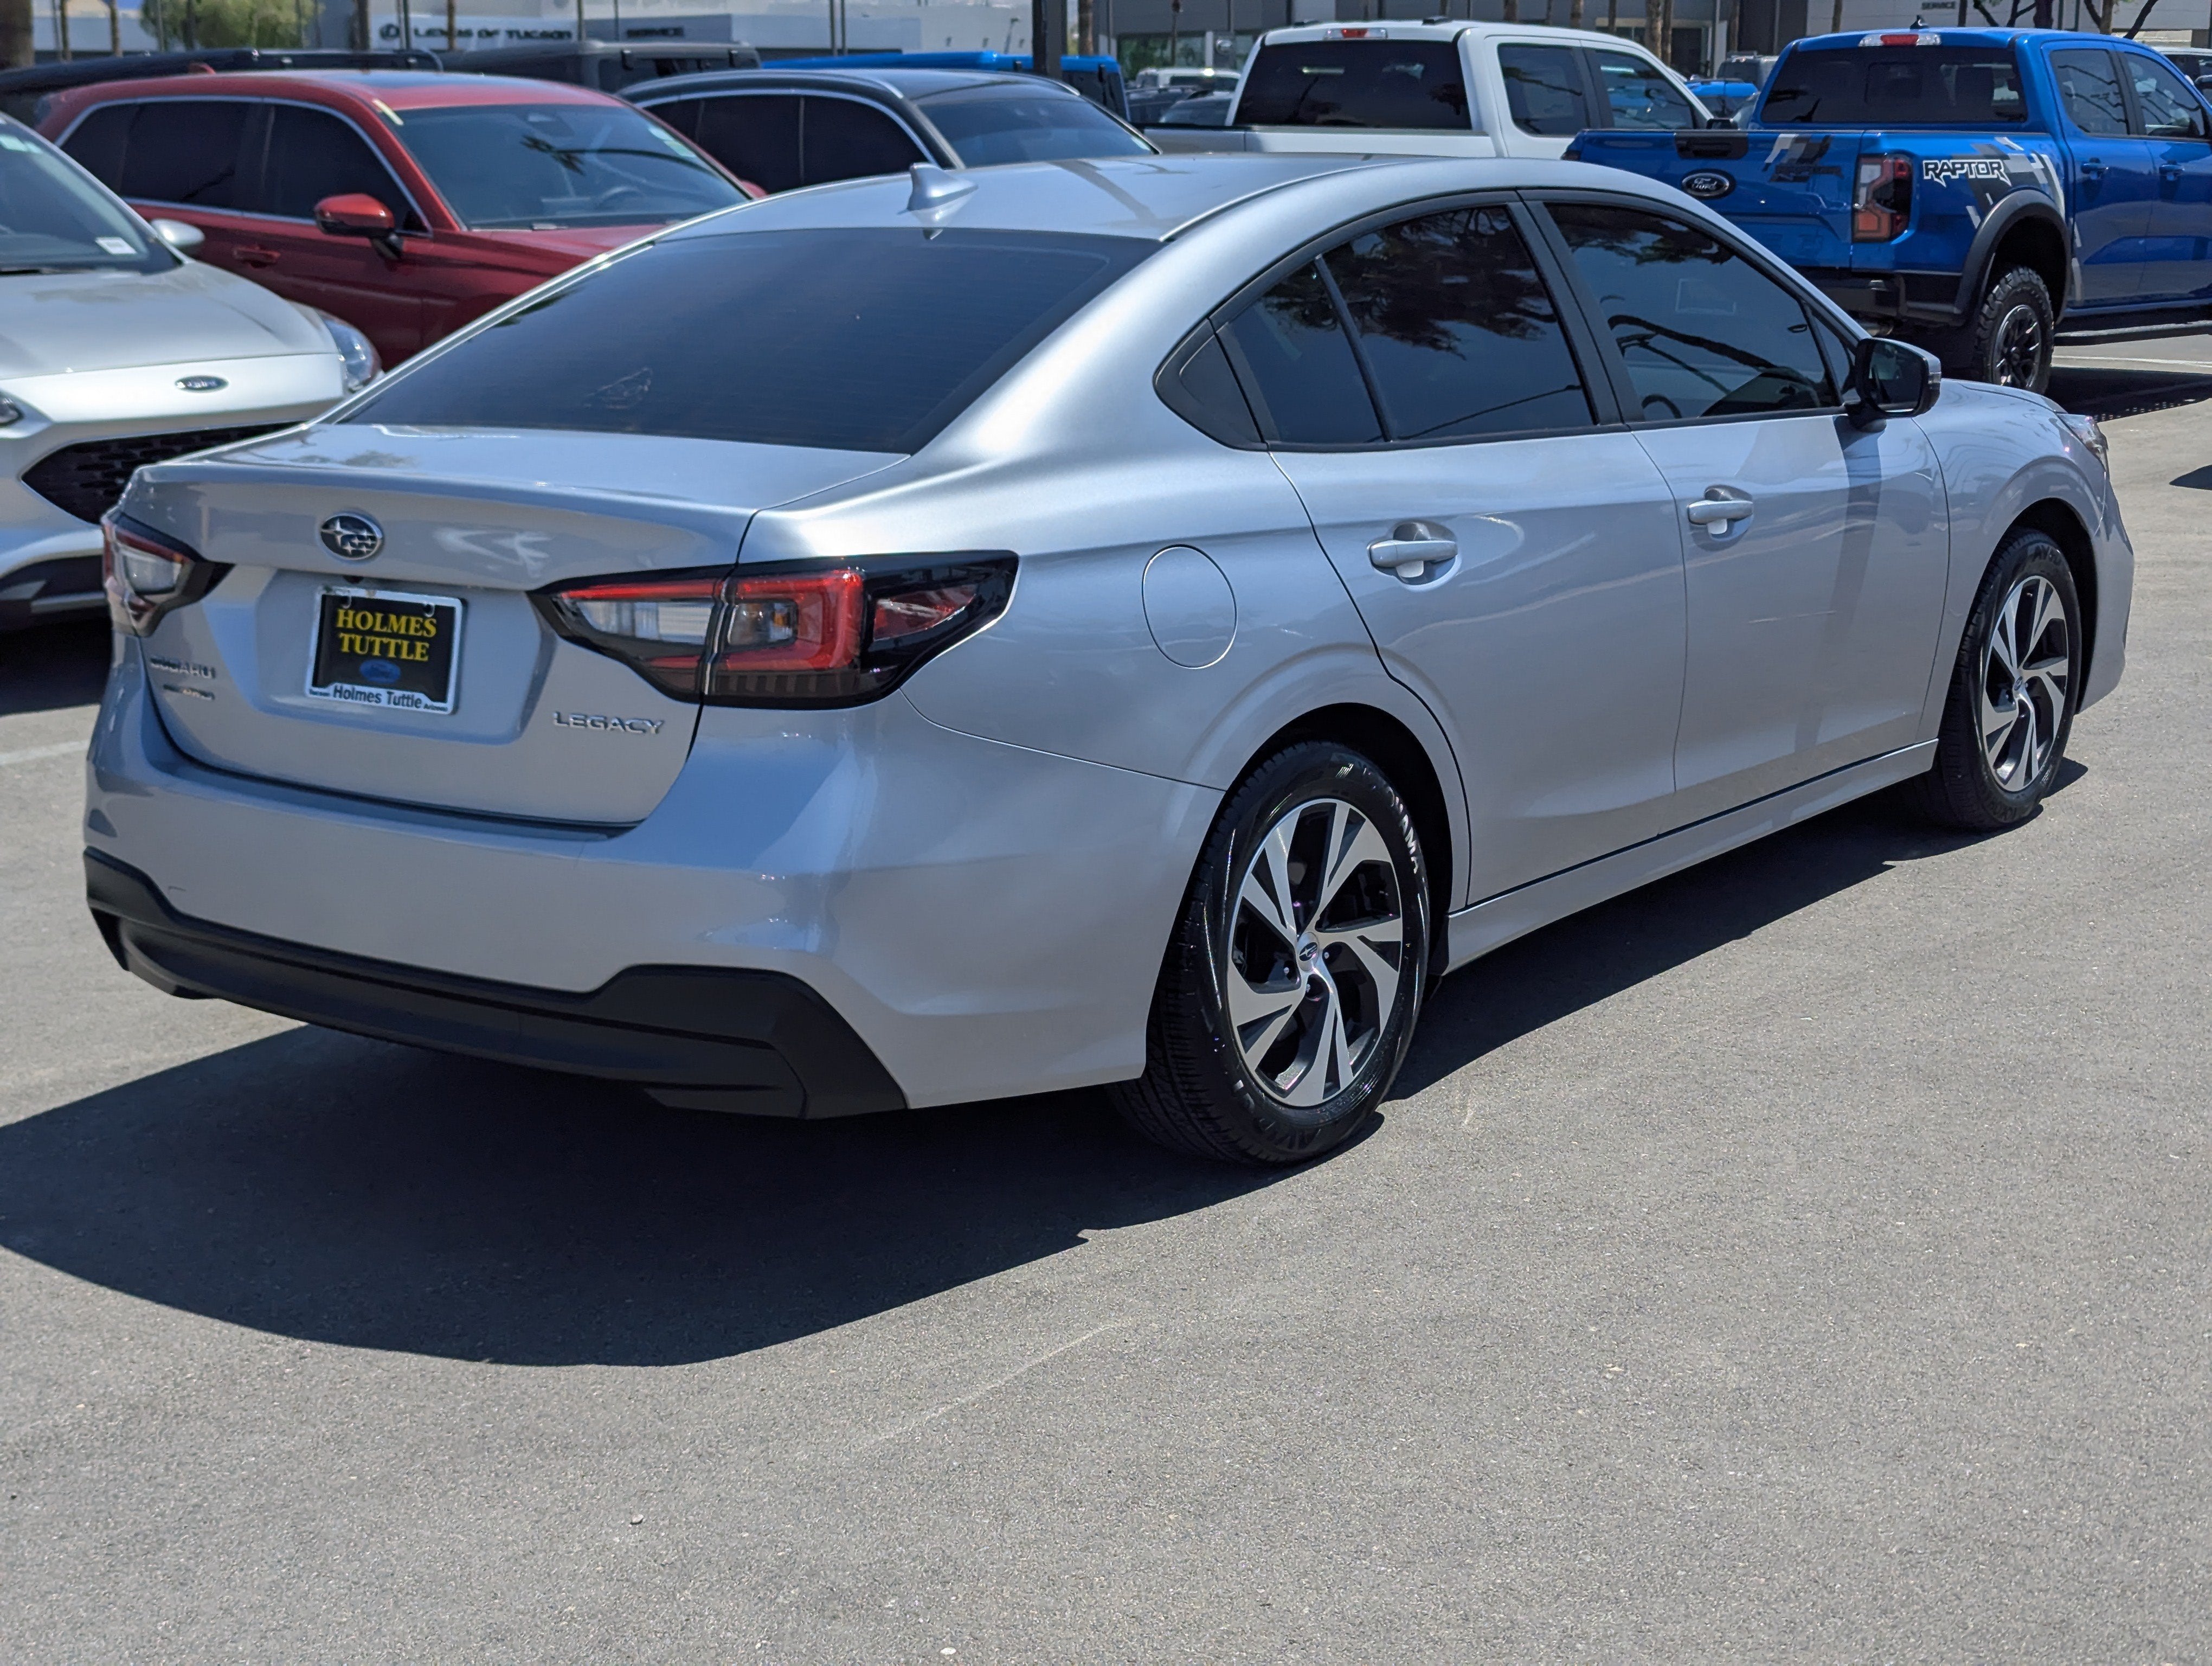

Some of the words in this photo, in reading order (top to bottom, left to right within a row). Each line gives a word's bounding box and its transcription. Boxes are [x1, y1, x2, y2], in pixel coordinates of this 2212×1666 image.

[414, 27, 473, 37] LEUS
[477, 28, 500, 39] OF
[505, 29, 572, 40] TUCSON
[1922, 159, 2012, 188] RAPTOR
[336, 608, 437, 638] HOLMES
[338, 632, 430, 662] TUTTLE
[333, 684, 382, 704] Holmes
[387, 690, 422, 709] Tuttle
[553, 710, 665, 734] LEGACY
